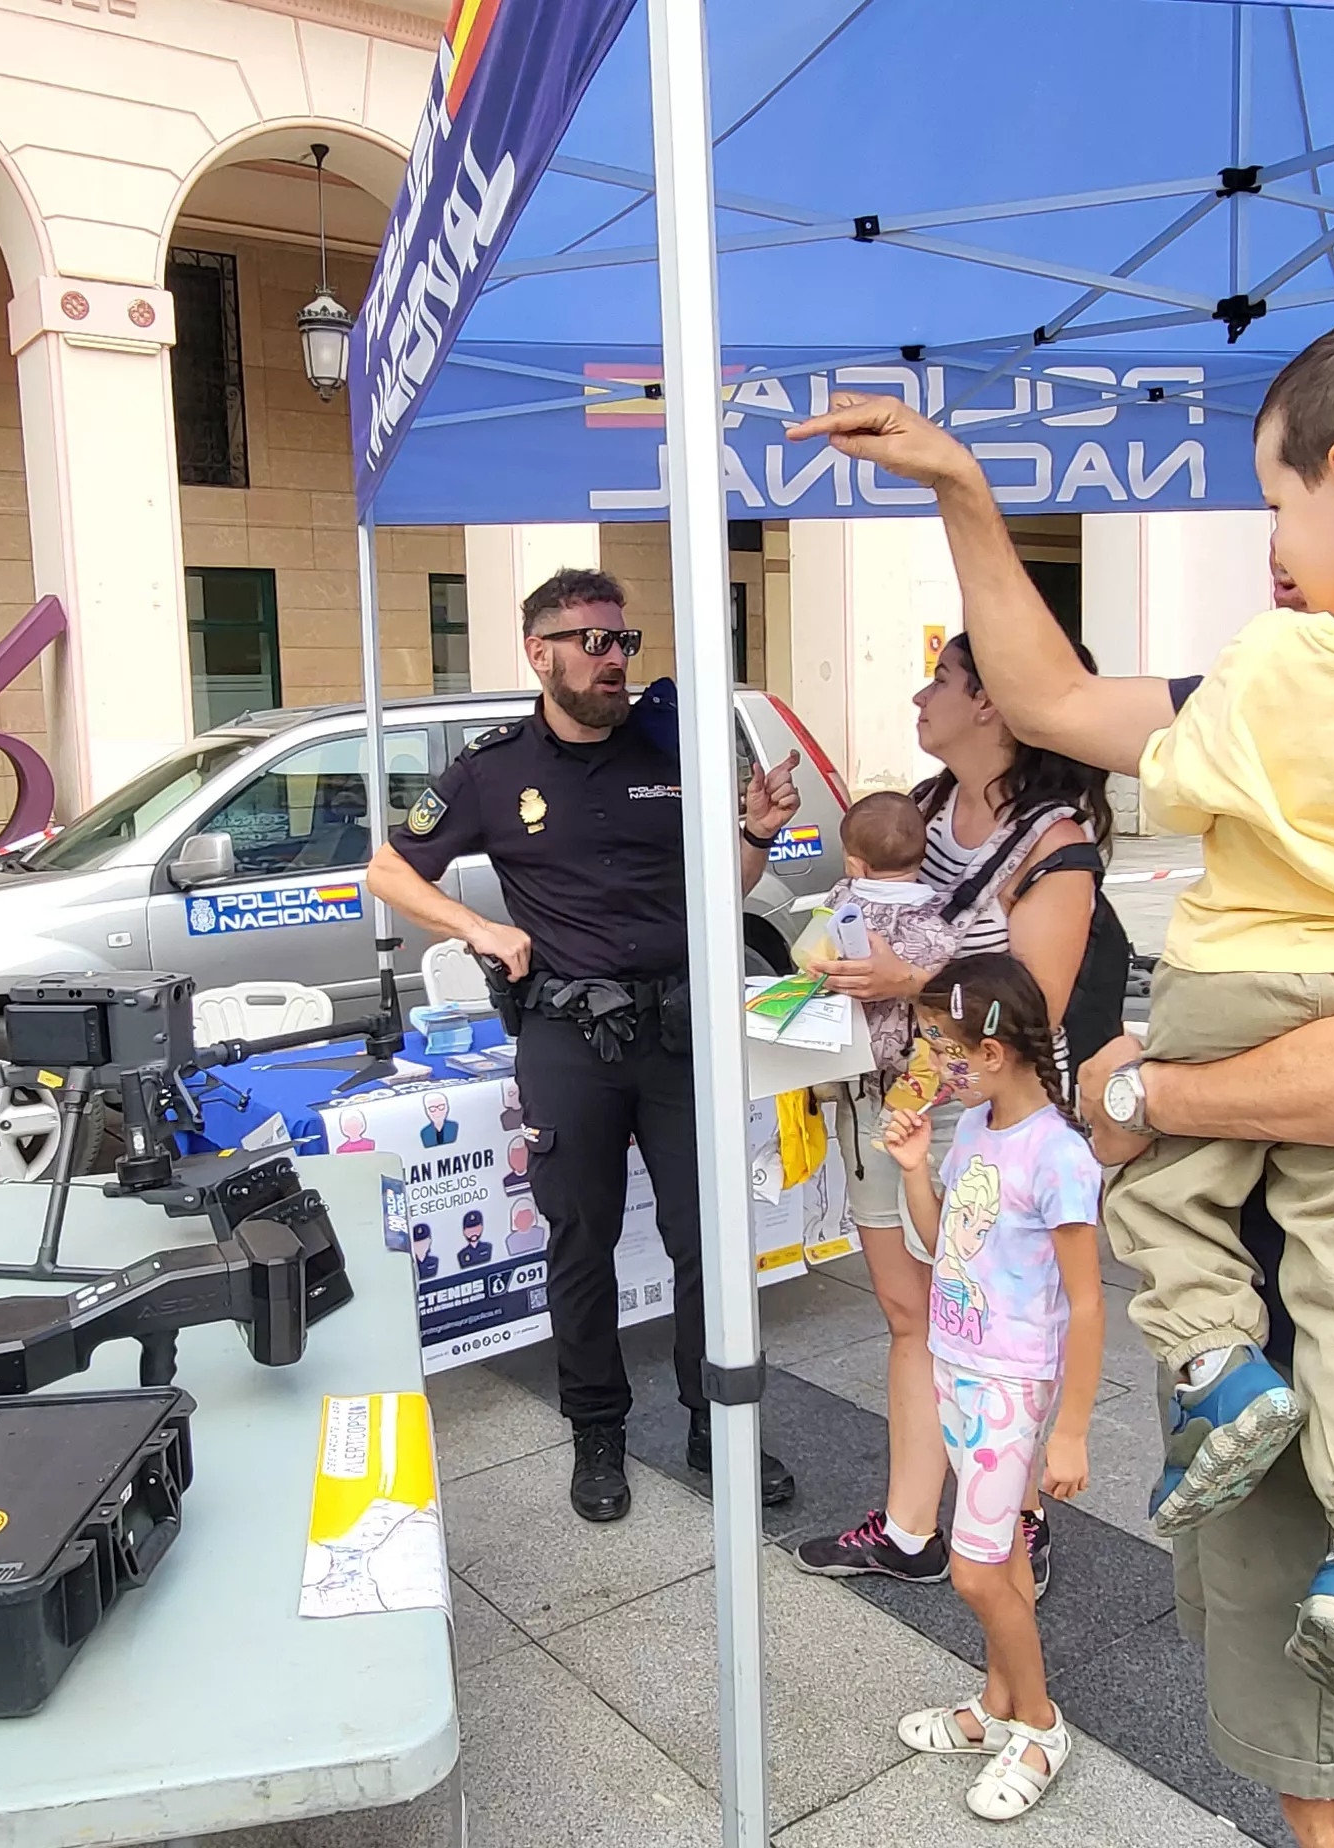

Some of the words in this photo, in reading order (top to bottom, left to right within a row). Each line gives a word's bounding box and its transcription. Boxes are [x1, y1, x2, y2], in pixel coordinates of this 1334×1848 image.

[767, 843, 823, 862] ONAL
[217, 889, 324, 913] POLICIA
[218, 903, 362, 931] NACIONAL
[437, 1148, 495, 1178] MAYOR
[410, 1174, 478, 1201] CONSEJOS
[419, 1187, 489, 1216] SEGURIDAD
[516, 1266, 544, 1285] 091
